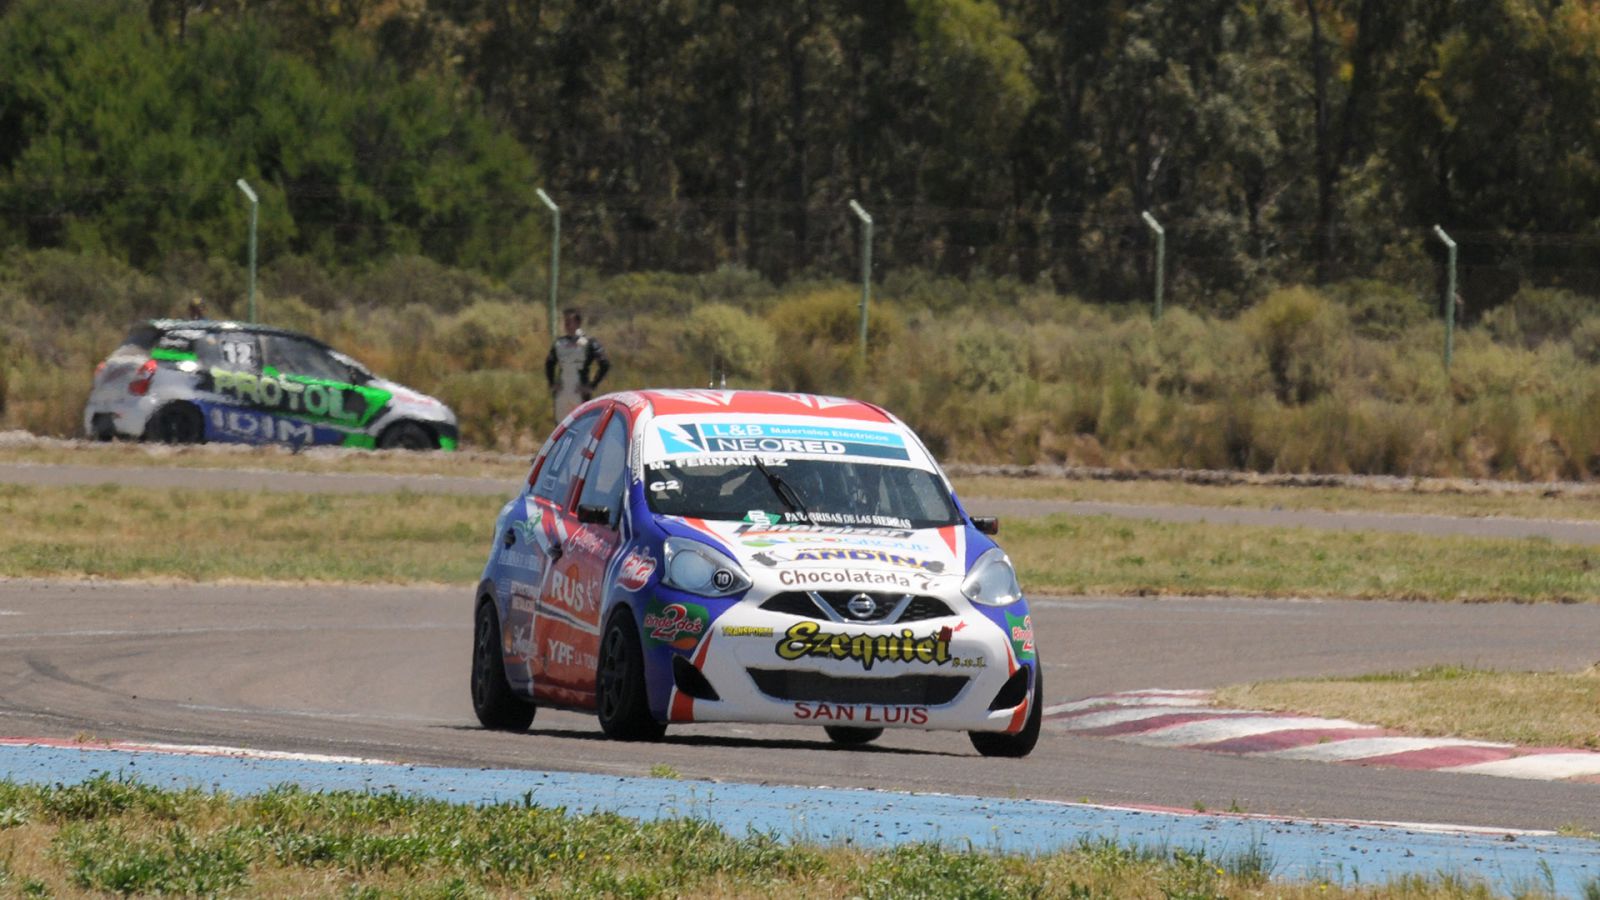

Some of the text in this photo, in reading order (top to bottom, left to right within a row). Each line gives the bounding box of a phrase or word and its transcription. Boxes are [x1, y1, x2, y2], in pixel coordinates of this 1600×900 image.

[210, 366, 358, 420] PROTOL
[210, 407, 314, 443] IDIM
[712, 424, 764, 436] L&B
[770, 426, 830, 437] Materiales
[717, 438, 847, 454] NEORED
[648, 460, 671, 470] M.
[649, 480, 680, 491] C2
[843, 514, 856, 524] DE
[855, 514, 872, 524] LAS
[716, 572, 730, 585] 10
[779, 569, 911, 586] Chocolatada
[551, 569, 584, 611] RUS
[547, 638, 575, 666] YPF
[793, 702, 929, 725] SAN LUIS
